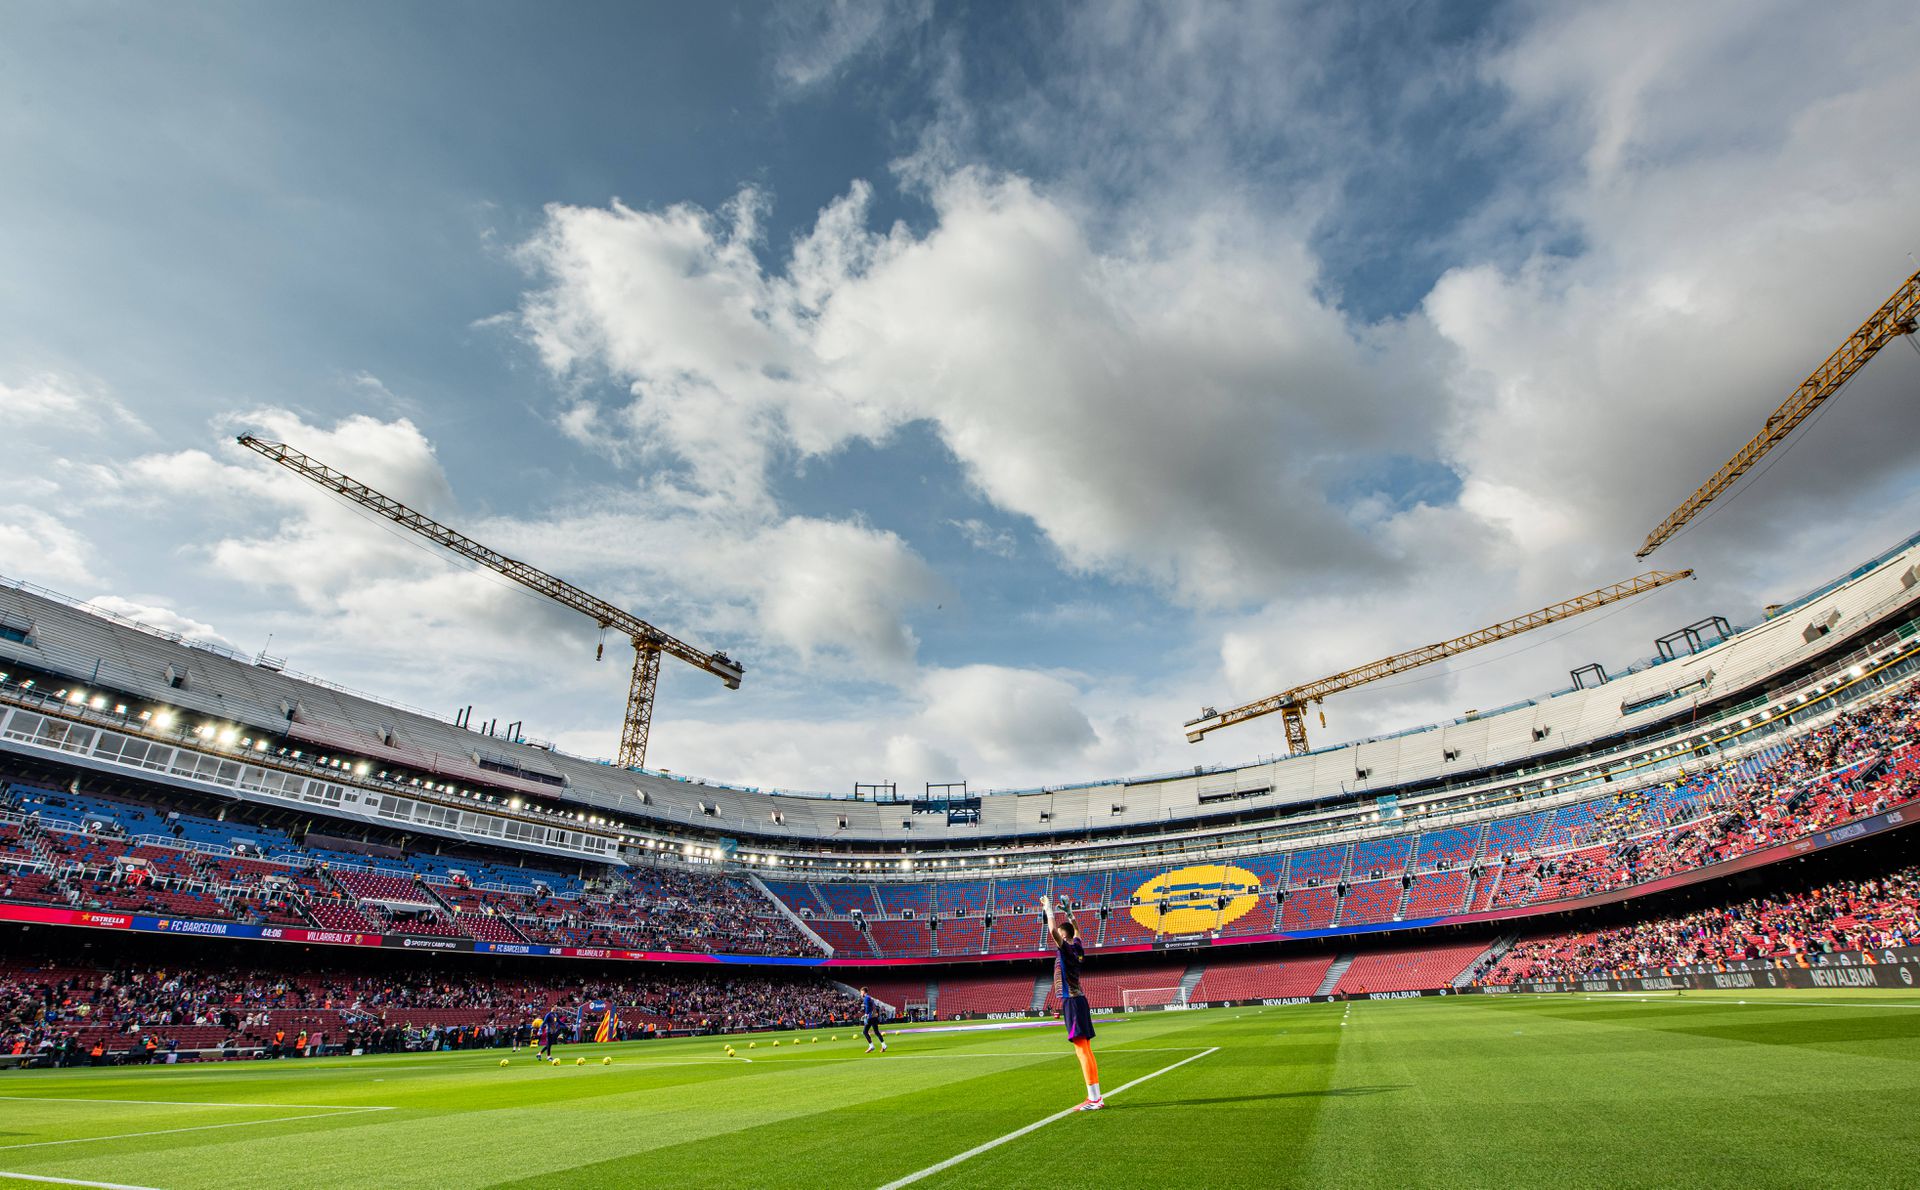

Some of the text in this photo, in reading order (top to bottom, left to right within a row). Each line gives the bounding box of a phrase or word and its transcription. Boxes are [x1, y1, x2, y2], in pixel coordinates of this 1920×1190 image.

[91, 915, 125, 924] ESTRELLA
[171, 920, 227, 934] FC BARCELONA
[261, 928, 282, 938] 44:06
[307, 931, 353, 943] VILLARREAL CF
[496, 944, 529, 954] FC BARCELONA
[1714, 973, 1756, 988] NEW ALBUM
[1809, 967, 1878, 987] NEW ALBUM
[1369, 990, 1422, 1000] NEW ALBUM
[1282, 997, 1311, 1005] ALBUM
